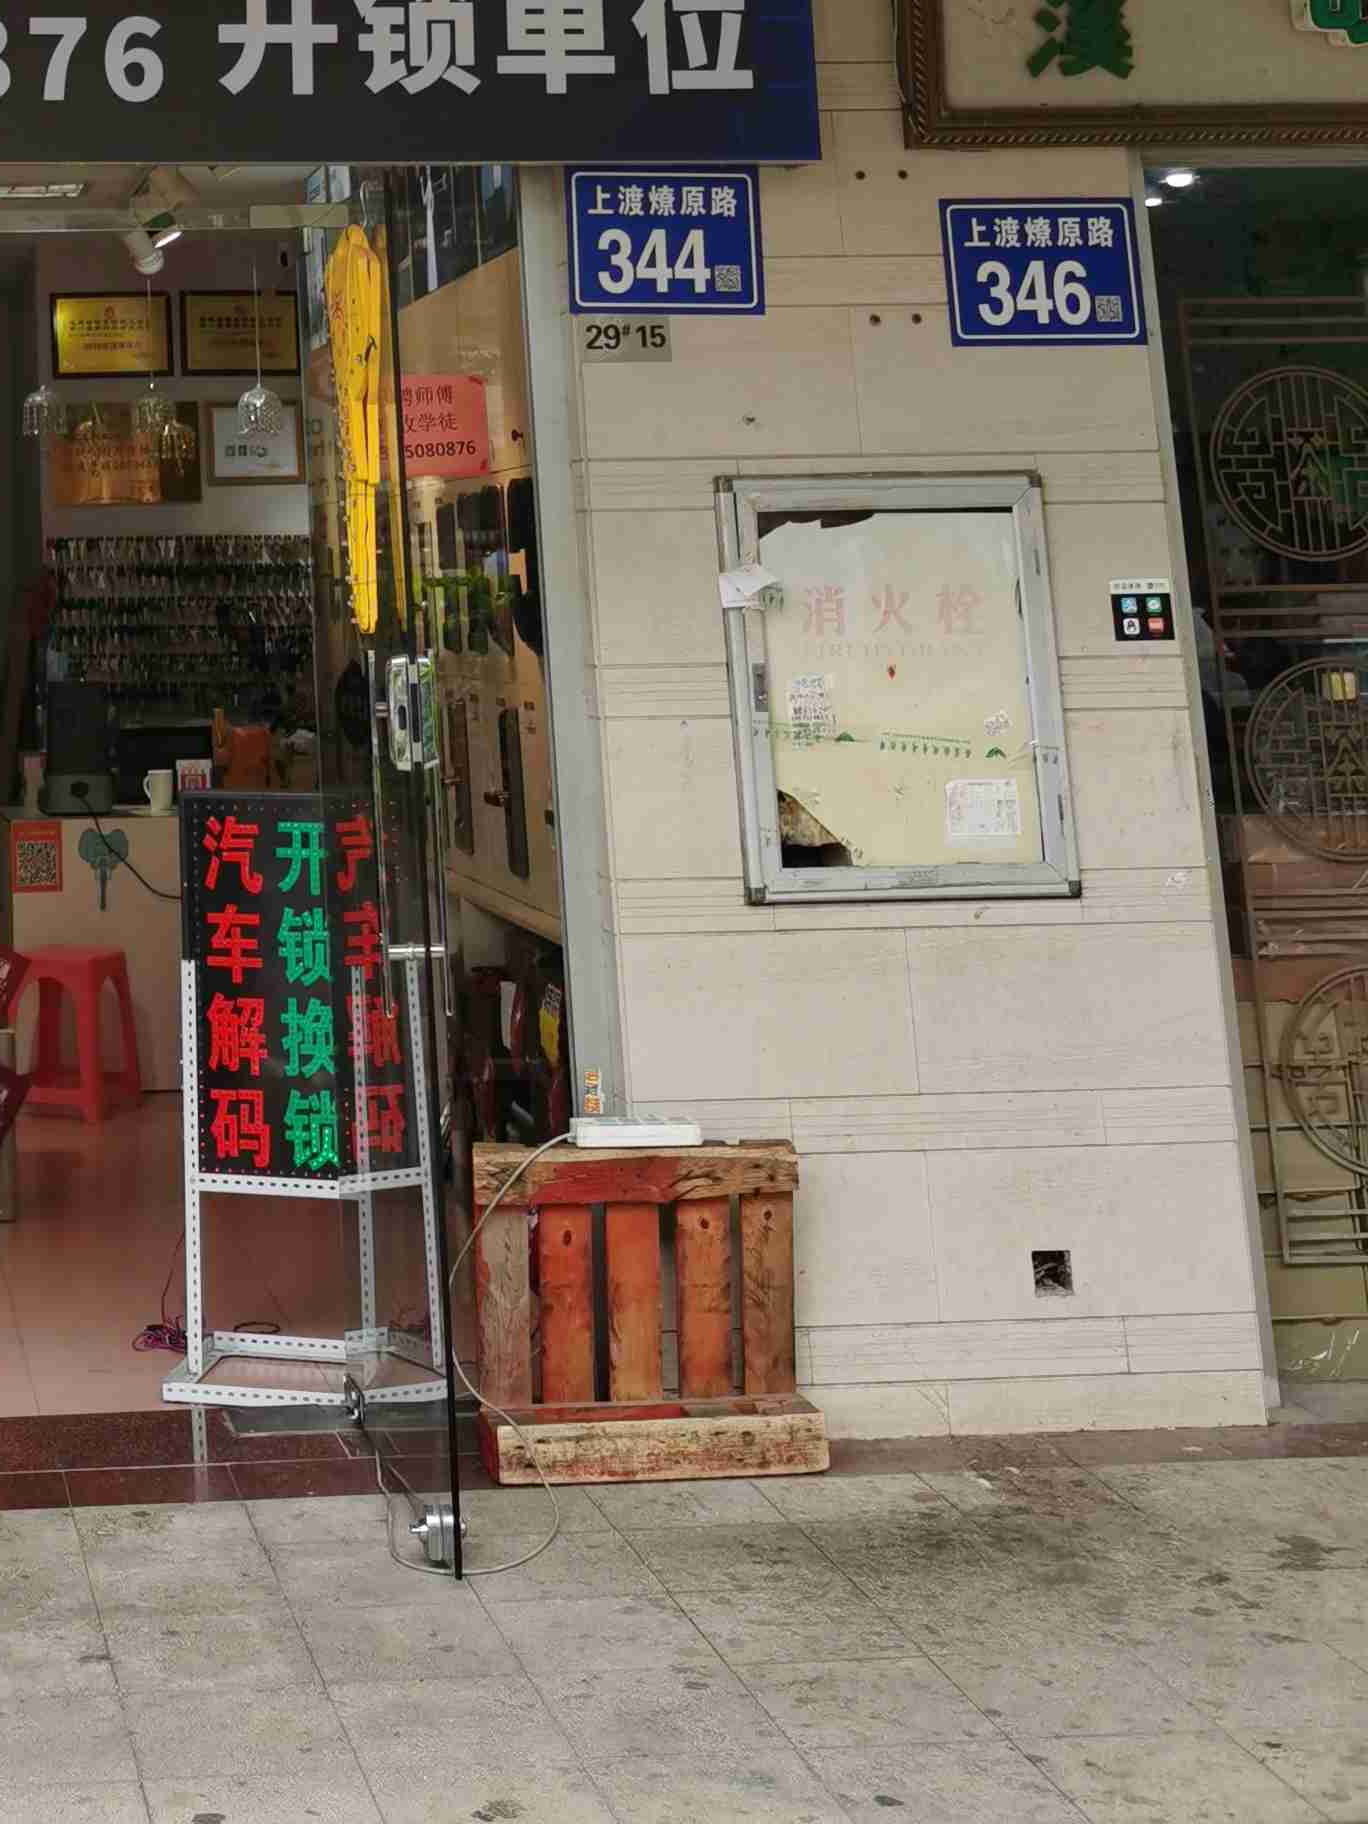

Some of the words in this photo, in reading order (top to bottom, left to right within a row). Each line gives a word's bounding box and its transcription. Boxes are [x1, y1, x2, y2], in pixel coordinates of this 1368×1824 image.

[587, 184, 738, 217] 上渡燎原路
[963, 216, 1115, 249] 上渡燎原路
[597, 228, 712, 294] 344
[976, 259, 1092, 327] 346
[800, 583, 985, 640] 消火栓
[202, 815, 273, 1170] 汽车解码
[275, 820, 339, 1171] 开锁换锁
